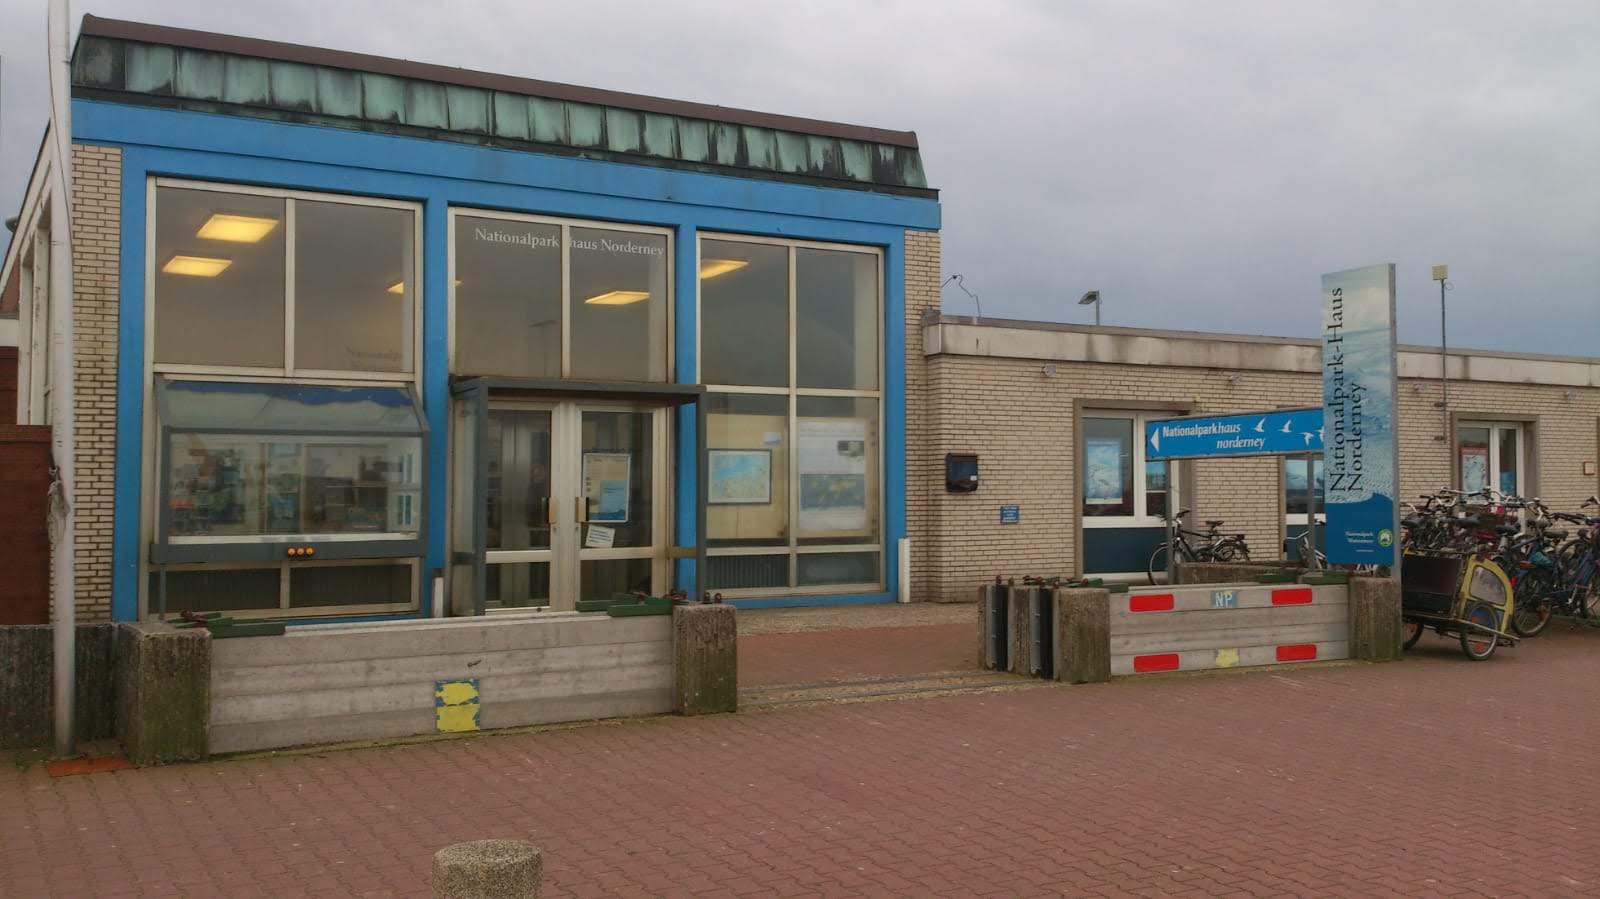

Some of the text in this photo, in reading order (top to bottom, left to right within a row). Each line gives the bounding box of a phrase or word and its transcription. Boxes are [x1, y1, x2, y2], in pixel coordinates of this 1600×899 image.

[601, 238, 664, 257] Norderney
[1327, 287, 1349, 492] Nationalpark-Haus
[1216, 436, 1266, 449] norderney
[1346, 382, 1367, 492] Norderney
[1215, 591, 1233, 608] NP
